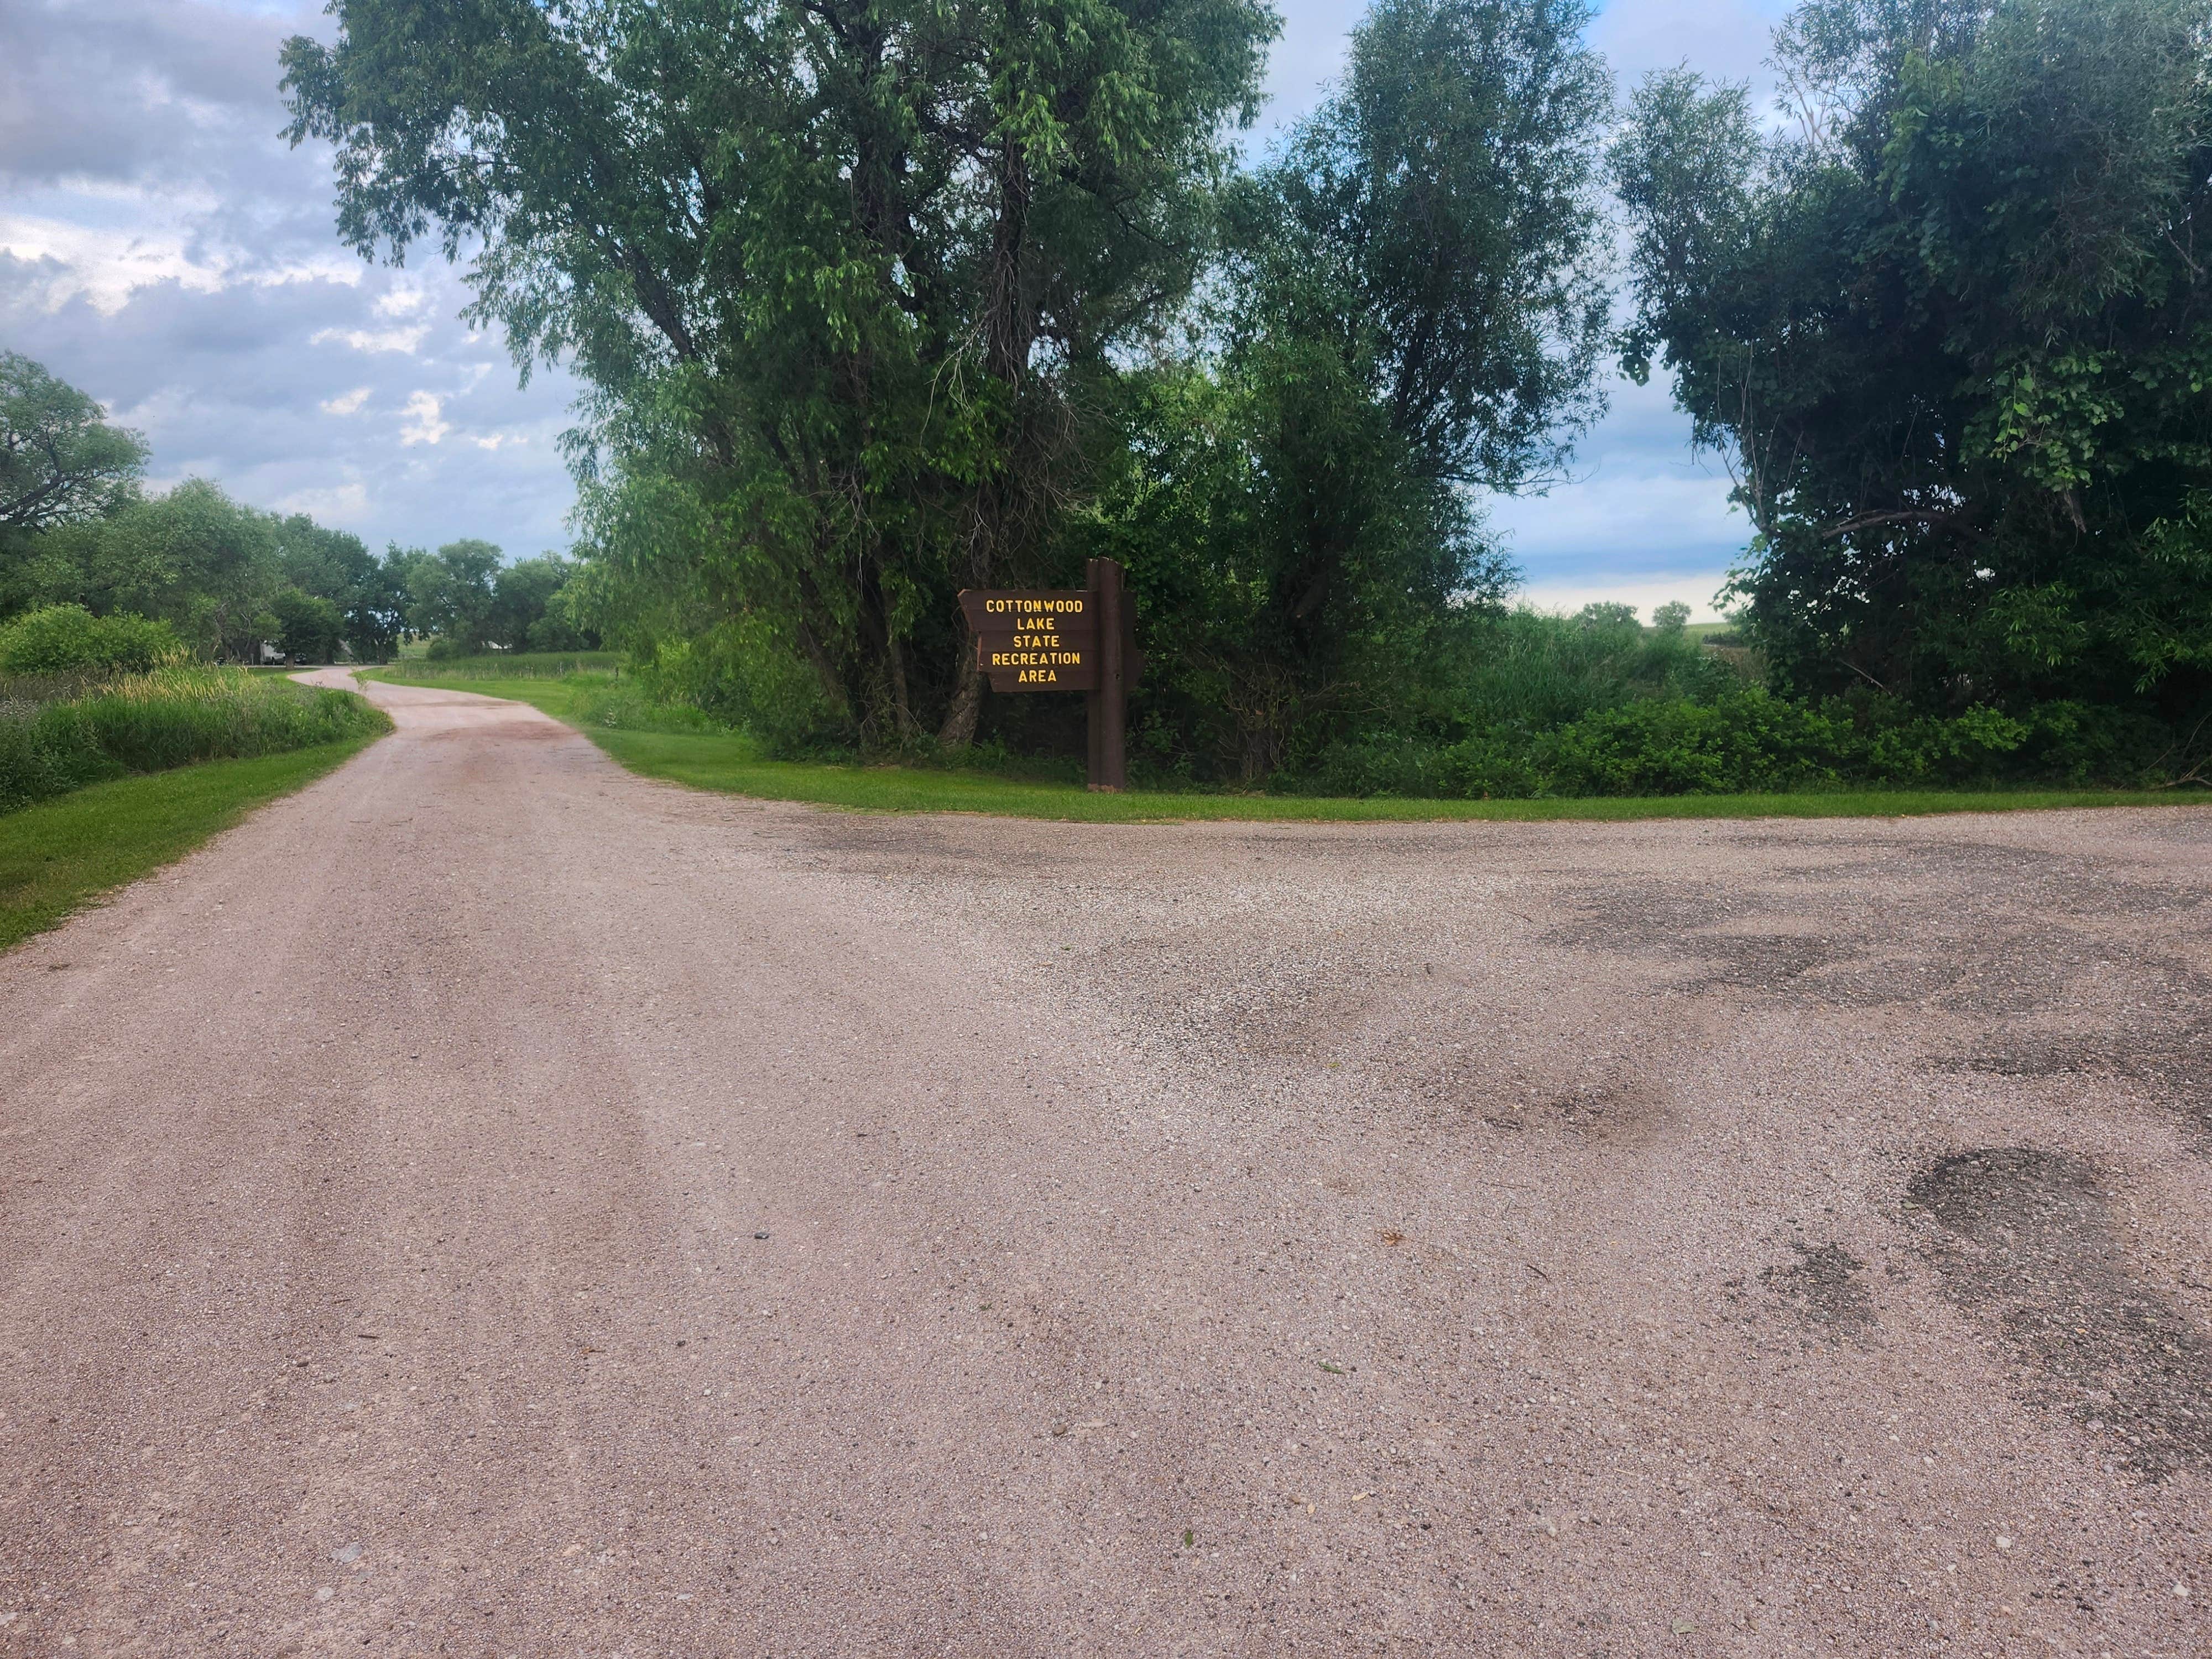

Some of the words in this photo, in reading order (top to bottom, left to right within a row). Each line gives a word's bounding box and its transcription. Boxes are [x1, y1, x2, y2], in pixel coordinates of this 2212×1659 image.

[986, 599, 1083, 613] COTTONWOOD
[1017, 618, 1055, 630] LAKE
[1013, 635, 1060, 648] STATE
[992, 652, 1080, 665] RECREATION
[1018, 670, 1057, 683] AREA
